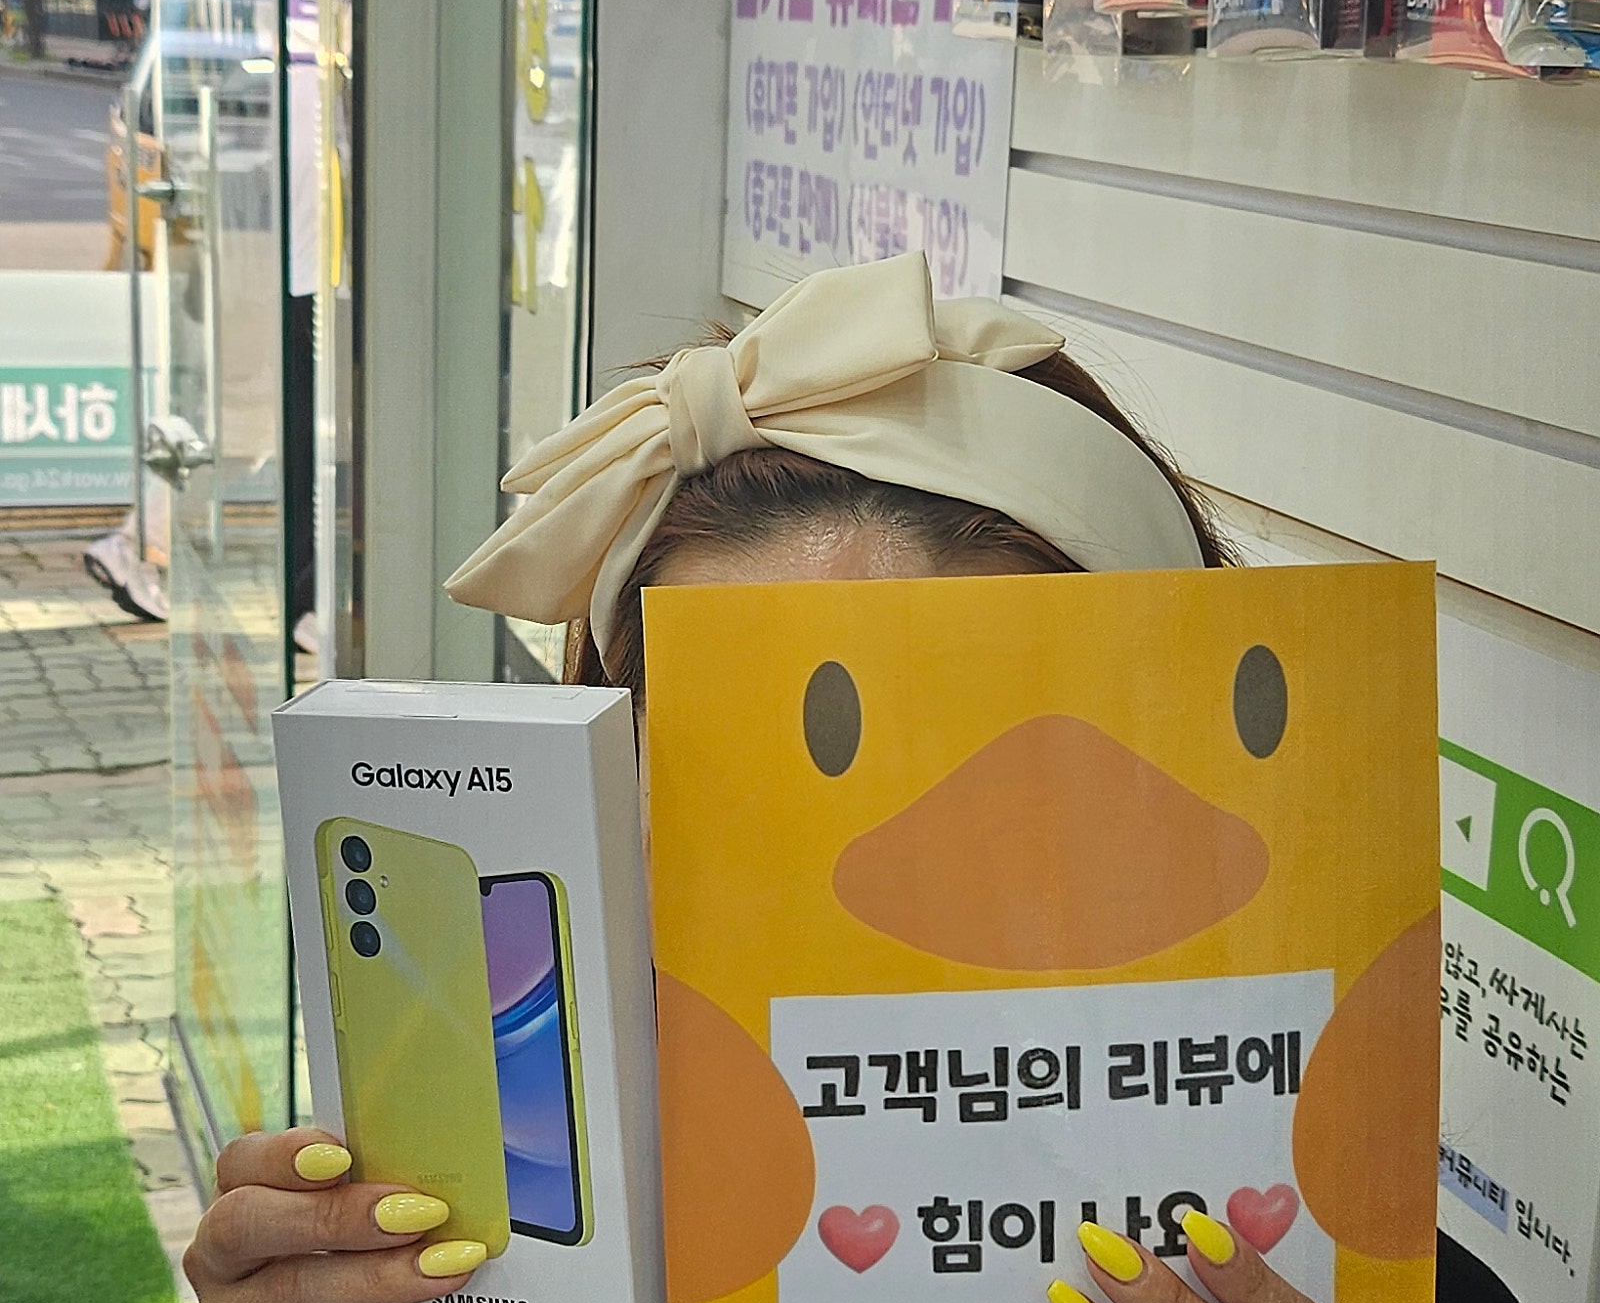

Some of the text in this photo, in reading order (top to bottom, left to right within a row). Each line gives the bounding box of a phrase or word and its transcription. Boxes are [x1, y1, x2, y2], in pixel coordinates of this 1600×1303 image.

[745, 55, 985, 177] (휴대폰 가입) (인터넷 가입)
[351, 761, 514, 798] Galaxy A15
[802, 1030, 1302, 1124] 고객님의 리뷰에
[1482, 1012, 1571, 1107] 공유하는
[917, 1196, 1056, 1274] 힘이
[1514, 1198, 1575, 1278] 입니다.
